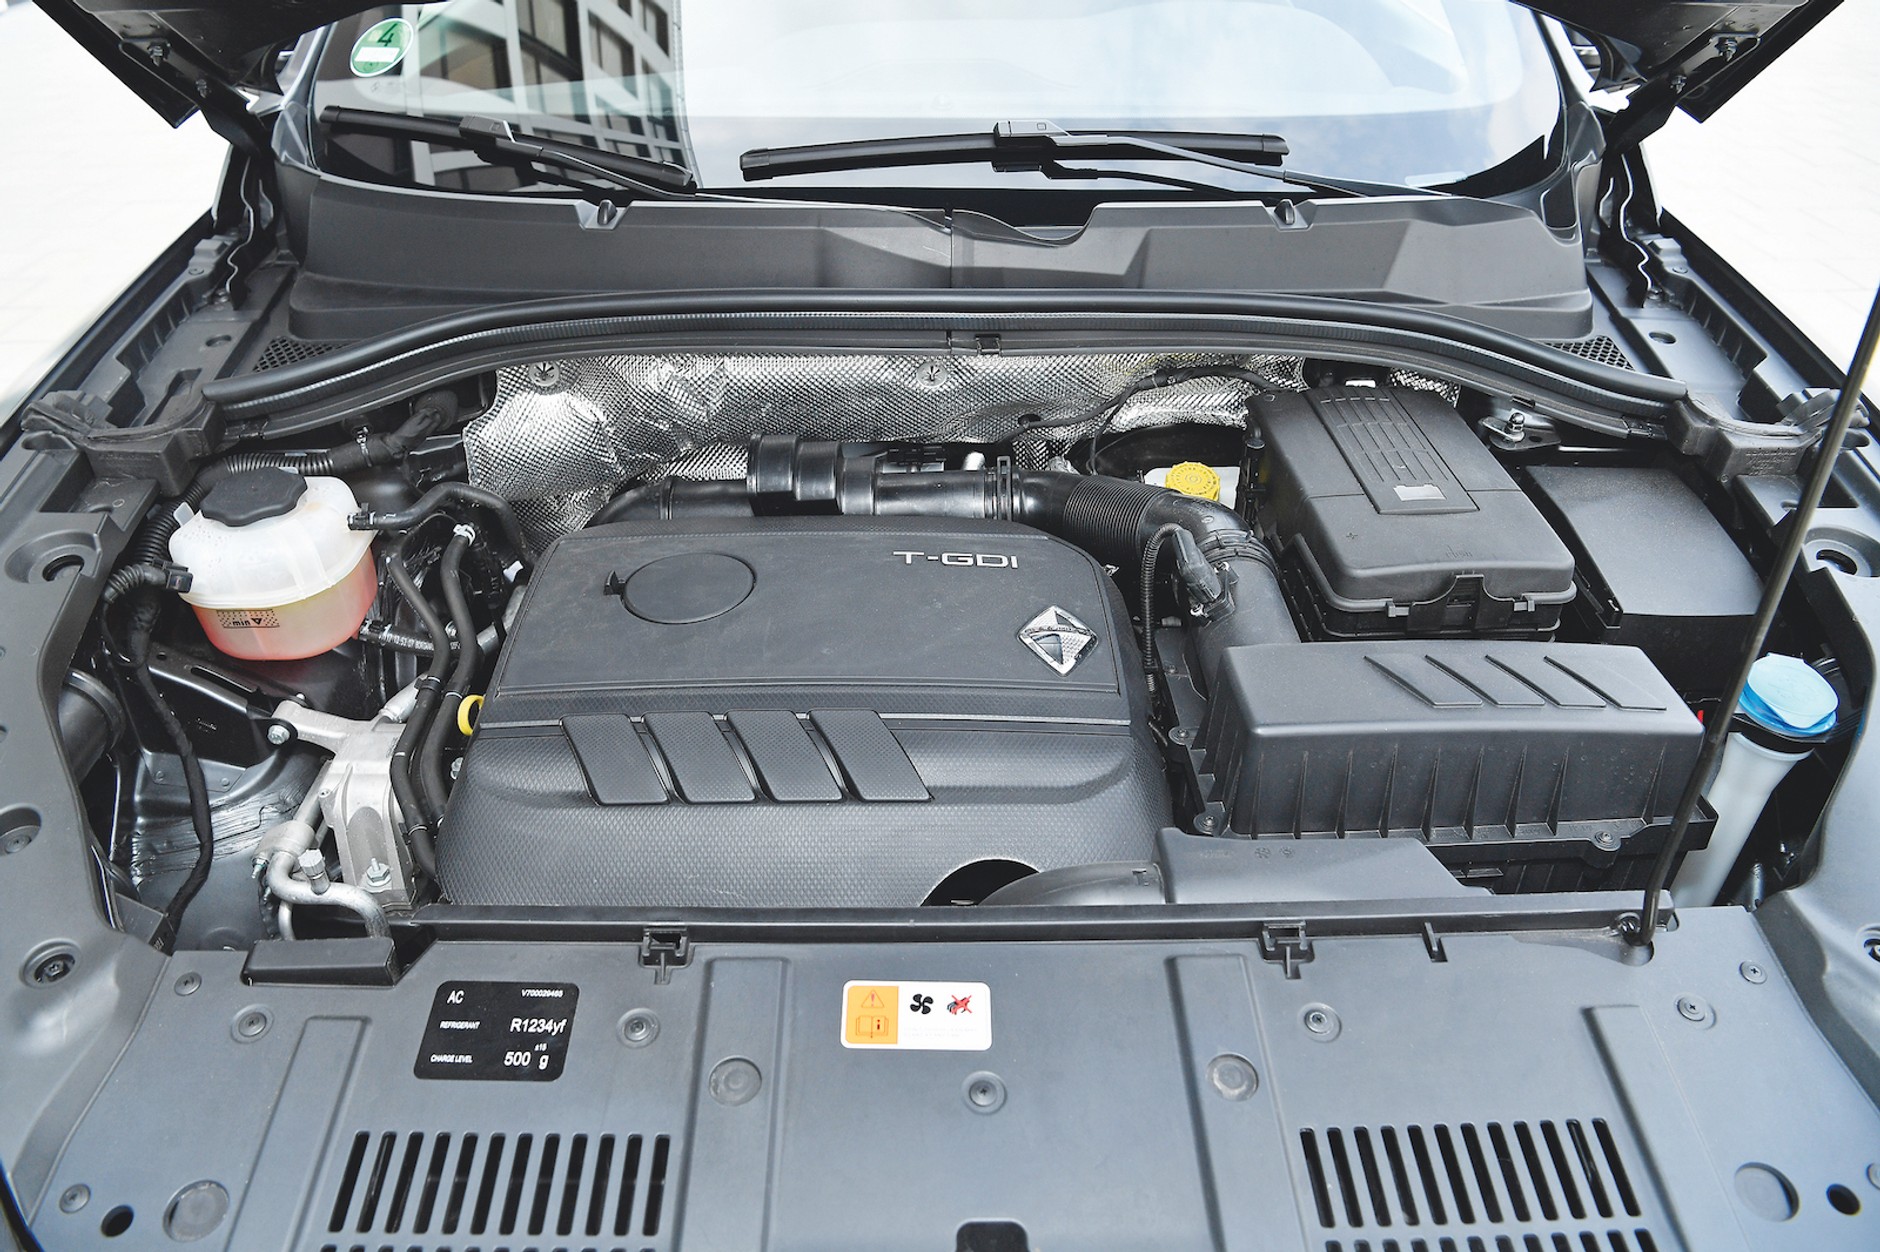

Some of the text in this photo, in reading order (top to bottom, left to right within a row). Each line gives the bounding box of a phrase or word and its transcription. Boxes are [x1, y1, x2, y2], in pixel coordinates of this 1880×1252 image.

[377, 23, 398, 47] 4
[893, 551, 1018, 569] T-GDI
[446, 990, 465, 1004] AC
[439, 1020, 481, 1030] REFRIGERANT
[509, 1017, 567, 1036] R1234yf
[430, 1054, 473, 1064] CHARGE LEVEL
[503, 1051, 550, 1070] 500 g
